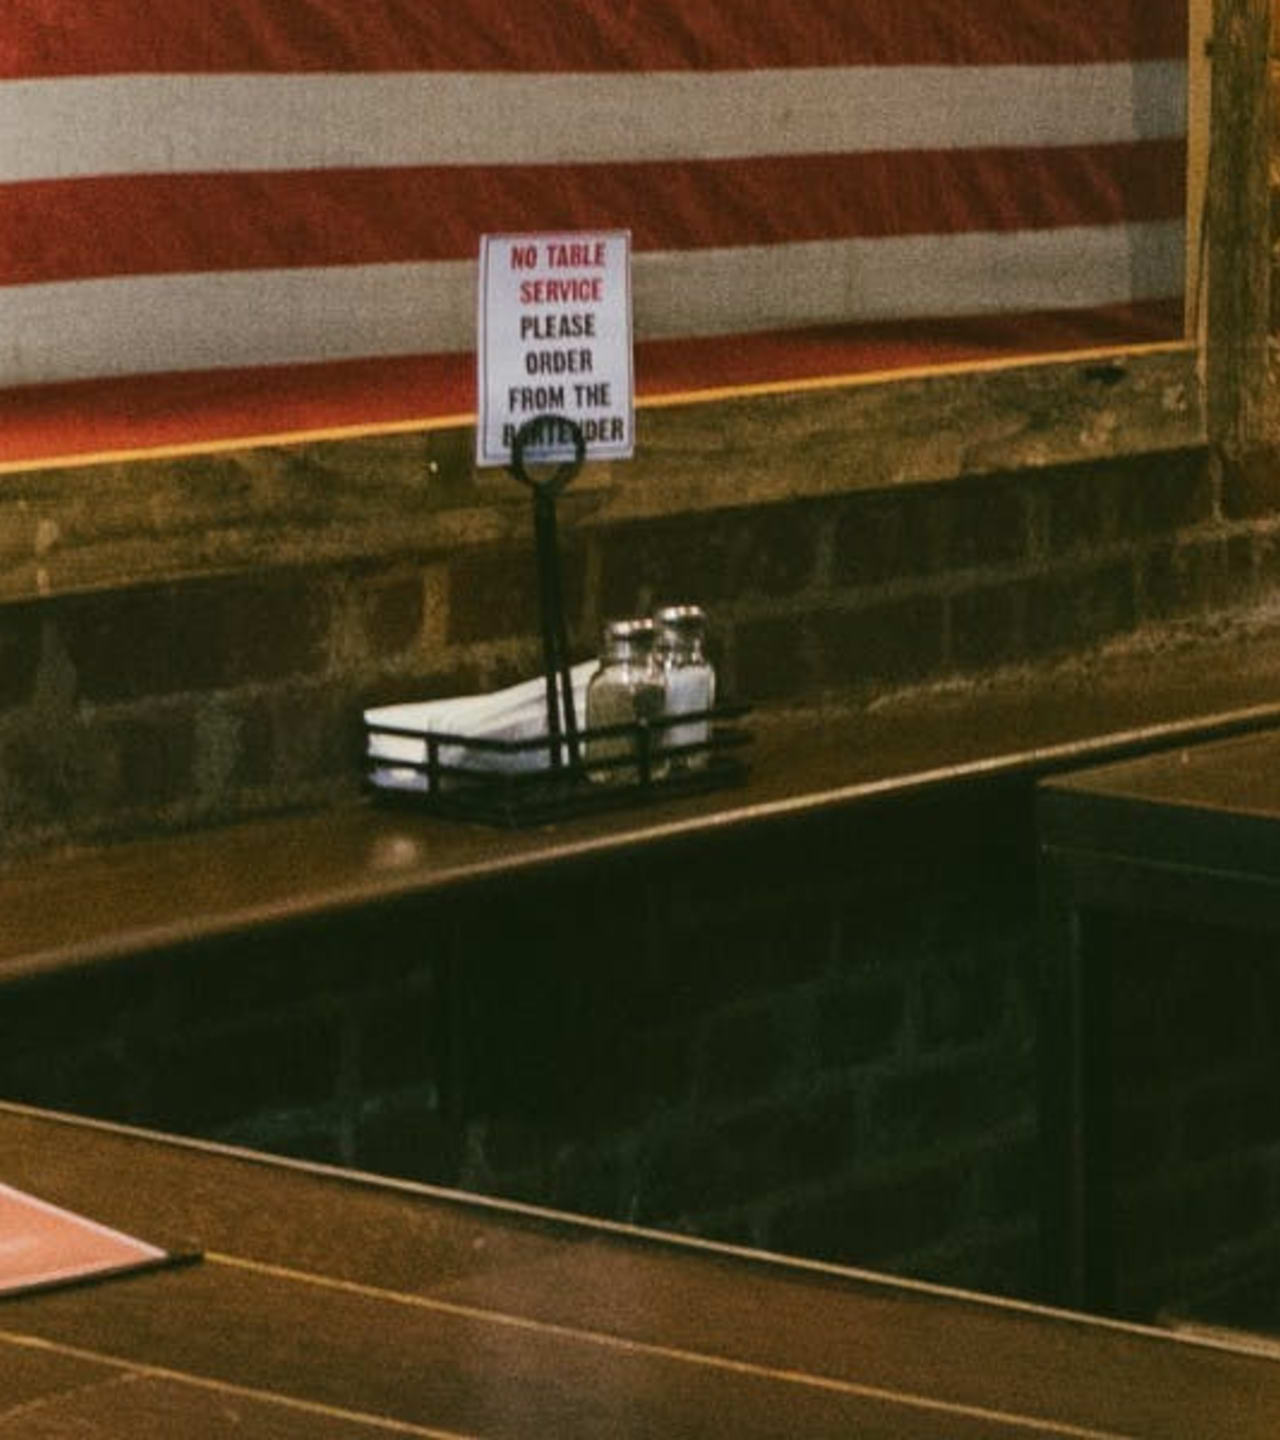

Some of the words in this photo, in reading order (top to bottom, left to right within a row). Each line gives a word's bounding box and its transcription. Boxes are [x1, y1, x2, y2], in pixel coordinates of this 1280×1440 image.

[511, 245, 537, 270] NO
[547, 242, 606, 269] TABLE
[519, 278, 603, 303] SERVICE
[520, 314, 596, 340] PLEASE
[525, 349, 593, 375] ORDER
[508, 386, 565, 412] FROM
[575, 383, 611, 407] THE
